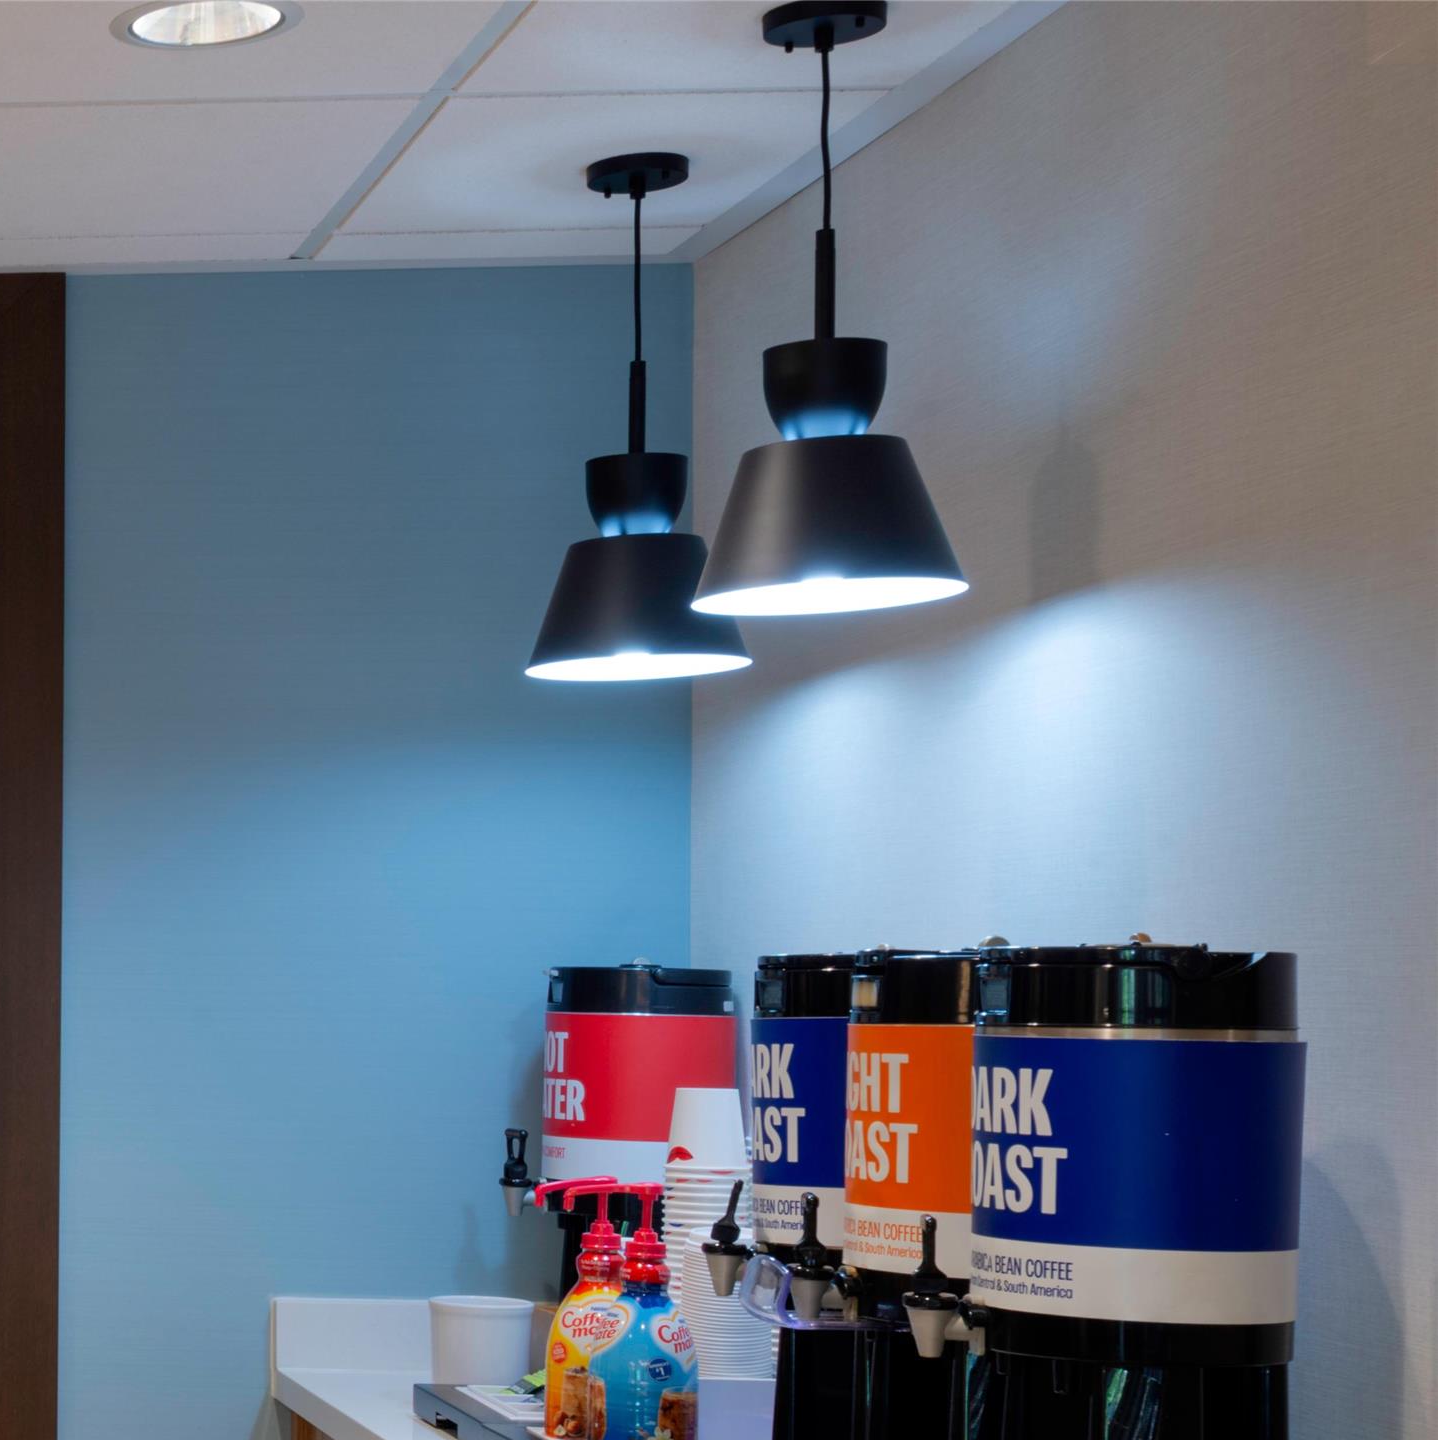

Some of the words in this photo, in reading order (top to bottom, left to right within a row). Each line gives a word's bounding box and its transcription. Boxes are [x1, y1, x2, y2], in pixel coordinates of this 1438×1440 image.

[544, 1031, 569, 1073] OT
[751, 1043, 795, 1099] ARK
[543, 1078, 586, 1121] TER
[971, 1065, 1054, 1136] ARK
[752, 1106, 806, 1163] AST
[843, 1118, 919, 1184] OAST
[971, 1140, 1068, 1215] OAST
[777, 1199, 805, 1217] COFF
[857, 1220, 881, 1238] BEAN
[883, 1223, 923, 1243] COFFEE
[994, 1255, 1022, 1276] BEAN
[1025, 1258, 1074, 1281] COFFEE
[1003, 1279, 1029, 1295] South
[1029, 1283, 1074, 1299] America
